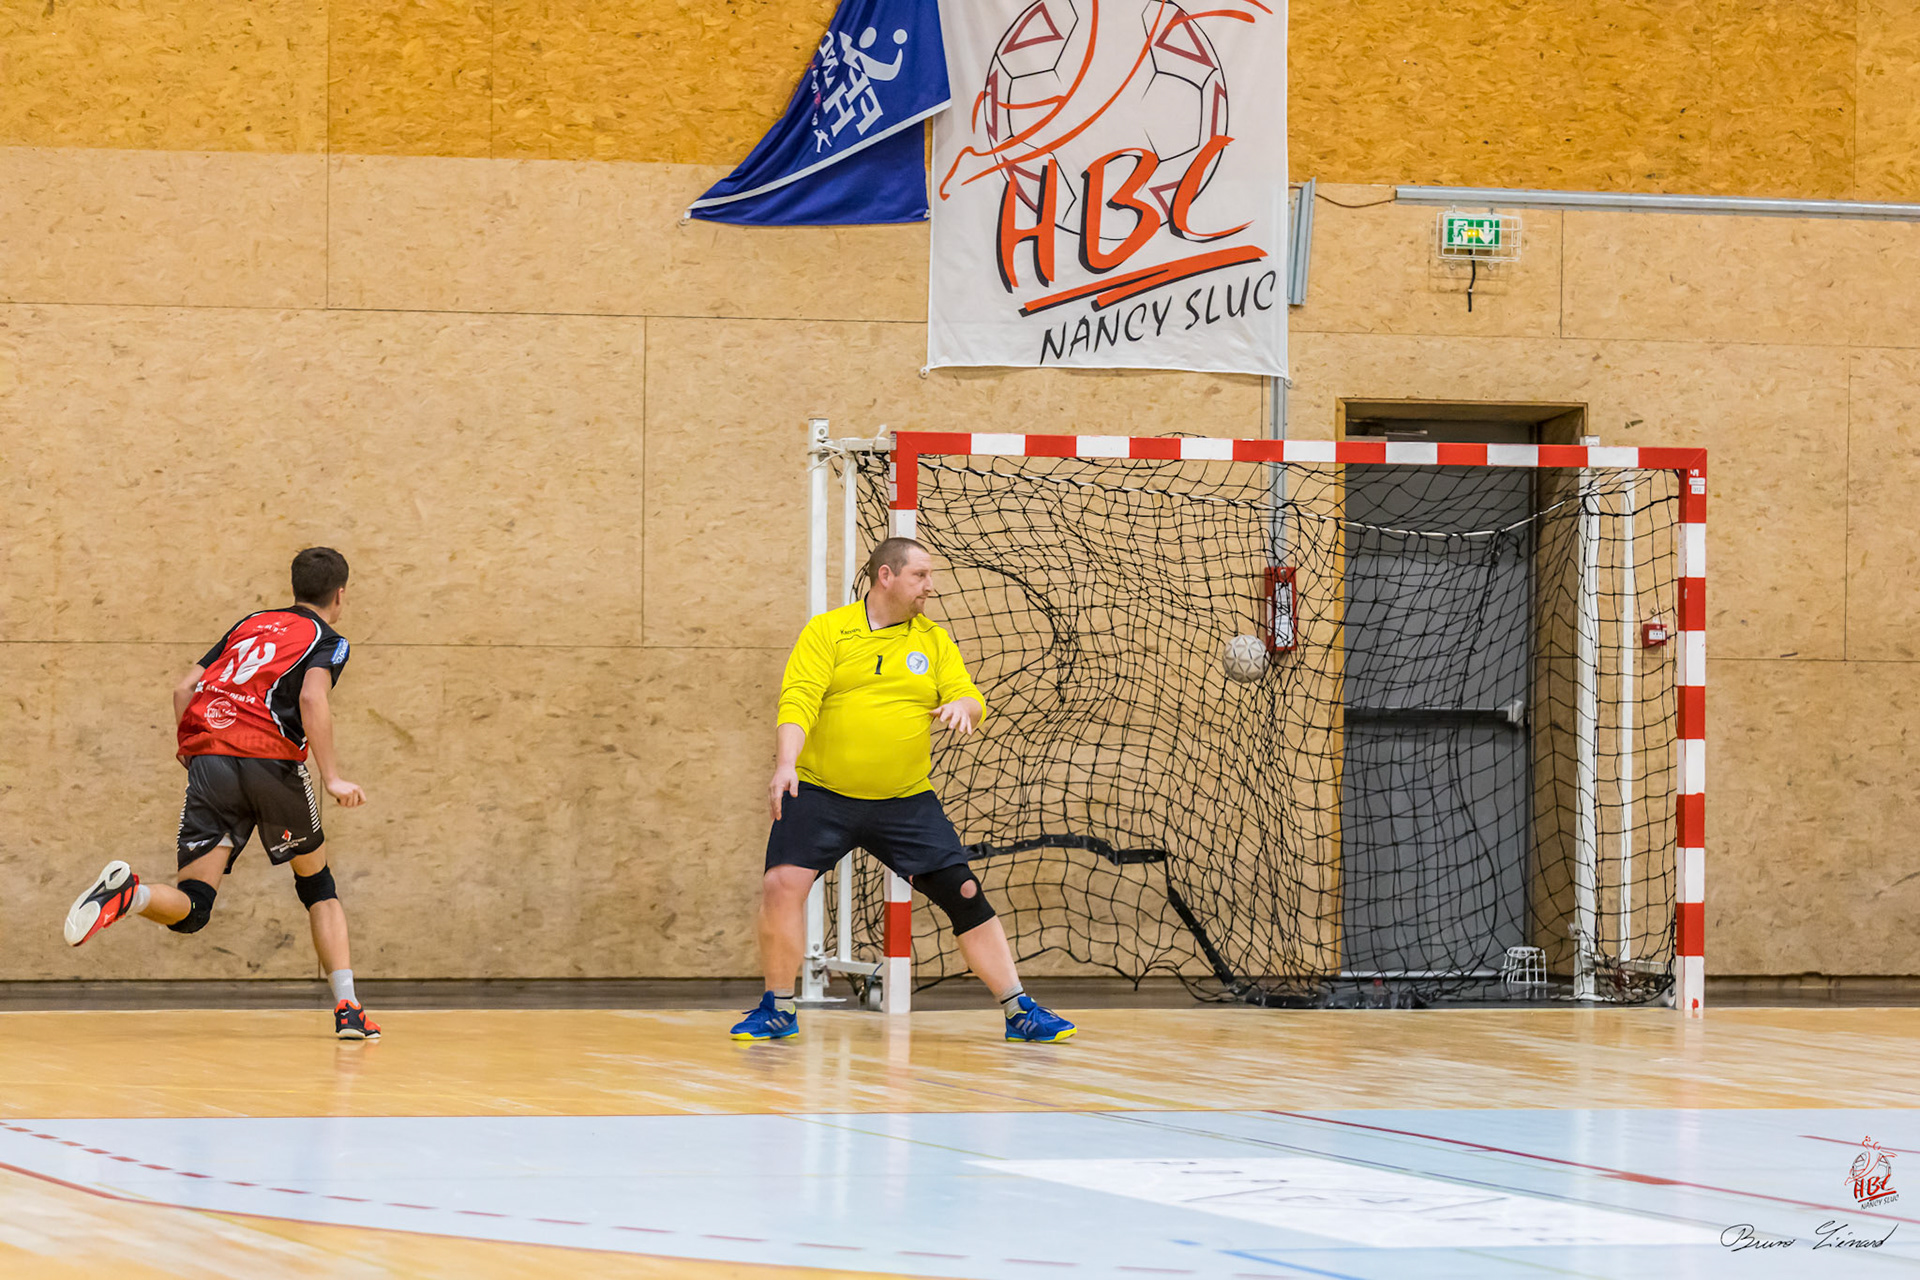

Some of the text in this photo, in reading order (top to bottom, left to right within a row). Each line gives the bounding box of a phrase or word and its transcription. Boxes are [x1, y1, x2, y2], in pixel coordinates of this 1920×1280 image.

[996, 135, 1255, 294] HBC
[1039, 270, 1277, 366] NANCY SLUC
[874, 655, 883, 675] 1
